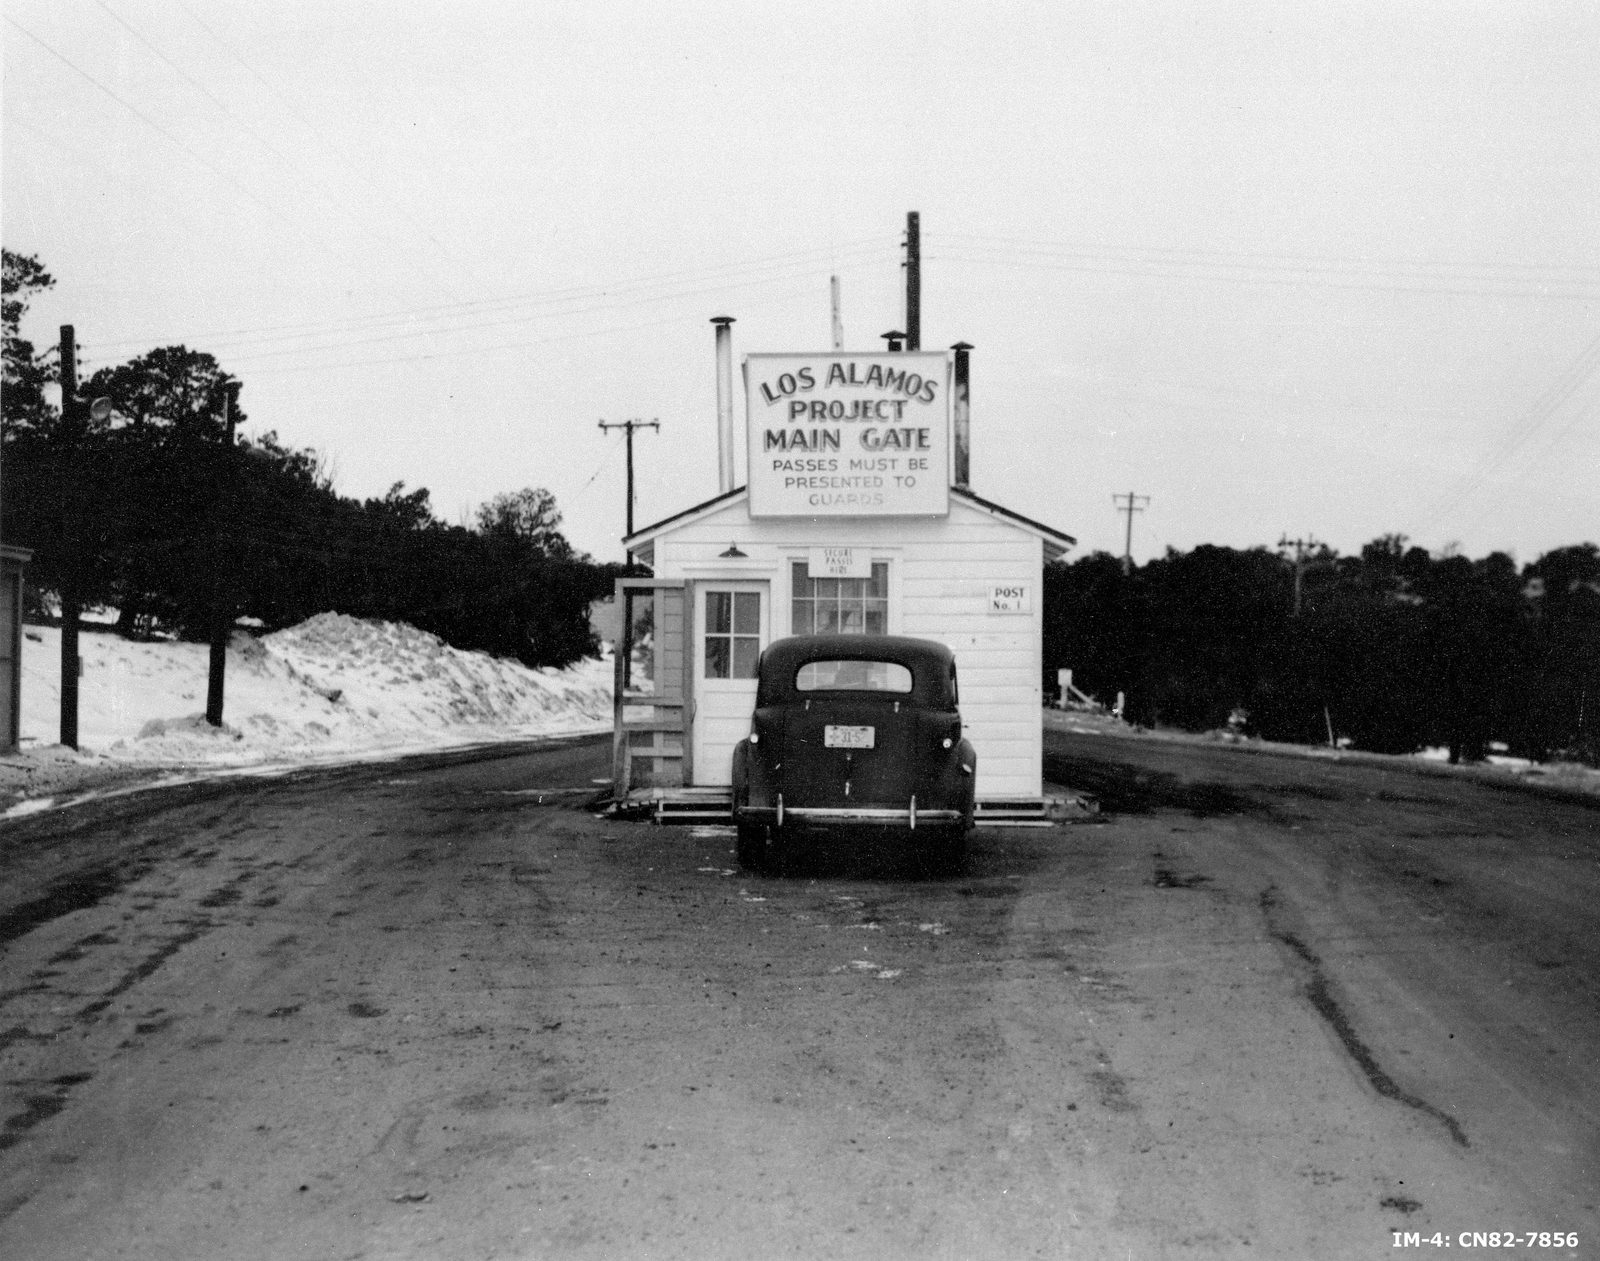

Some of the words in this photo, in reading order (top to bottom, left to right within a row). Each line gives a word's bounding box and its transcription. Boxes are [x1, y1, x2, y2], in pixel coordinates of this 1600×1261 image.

[759, 366, 816, 406] LOS
[825, 362, 939, 404] ALAMOS
[788, 399, 908, 422] PROJECT
[764, 428, 841, 452] MAIN
[859, 427, 931, 452] GATE
[772, 459, 839, 472] PASSES
[849, 458, 899, 471] MUST
[908, 458, 929, 471] BE
[784, 476, 884, 489] PRESENTED
[893, 475, 917, 488] TO
[808, 493, 885, 507] GUARDS
[994, 587, 1024, 599] POST
